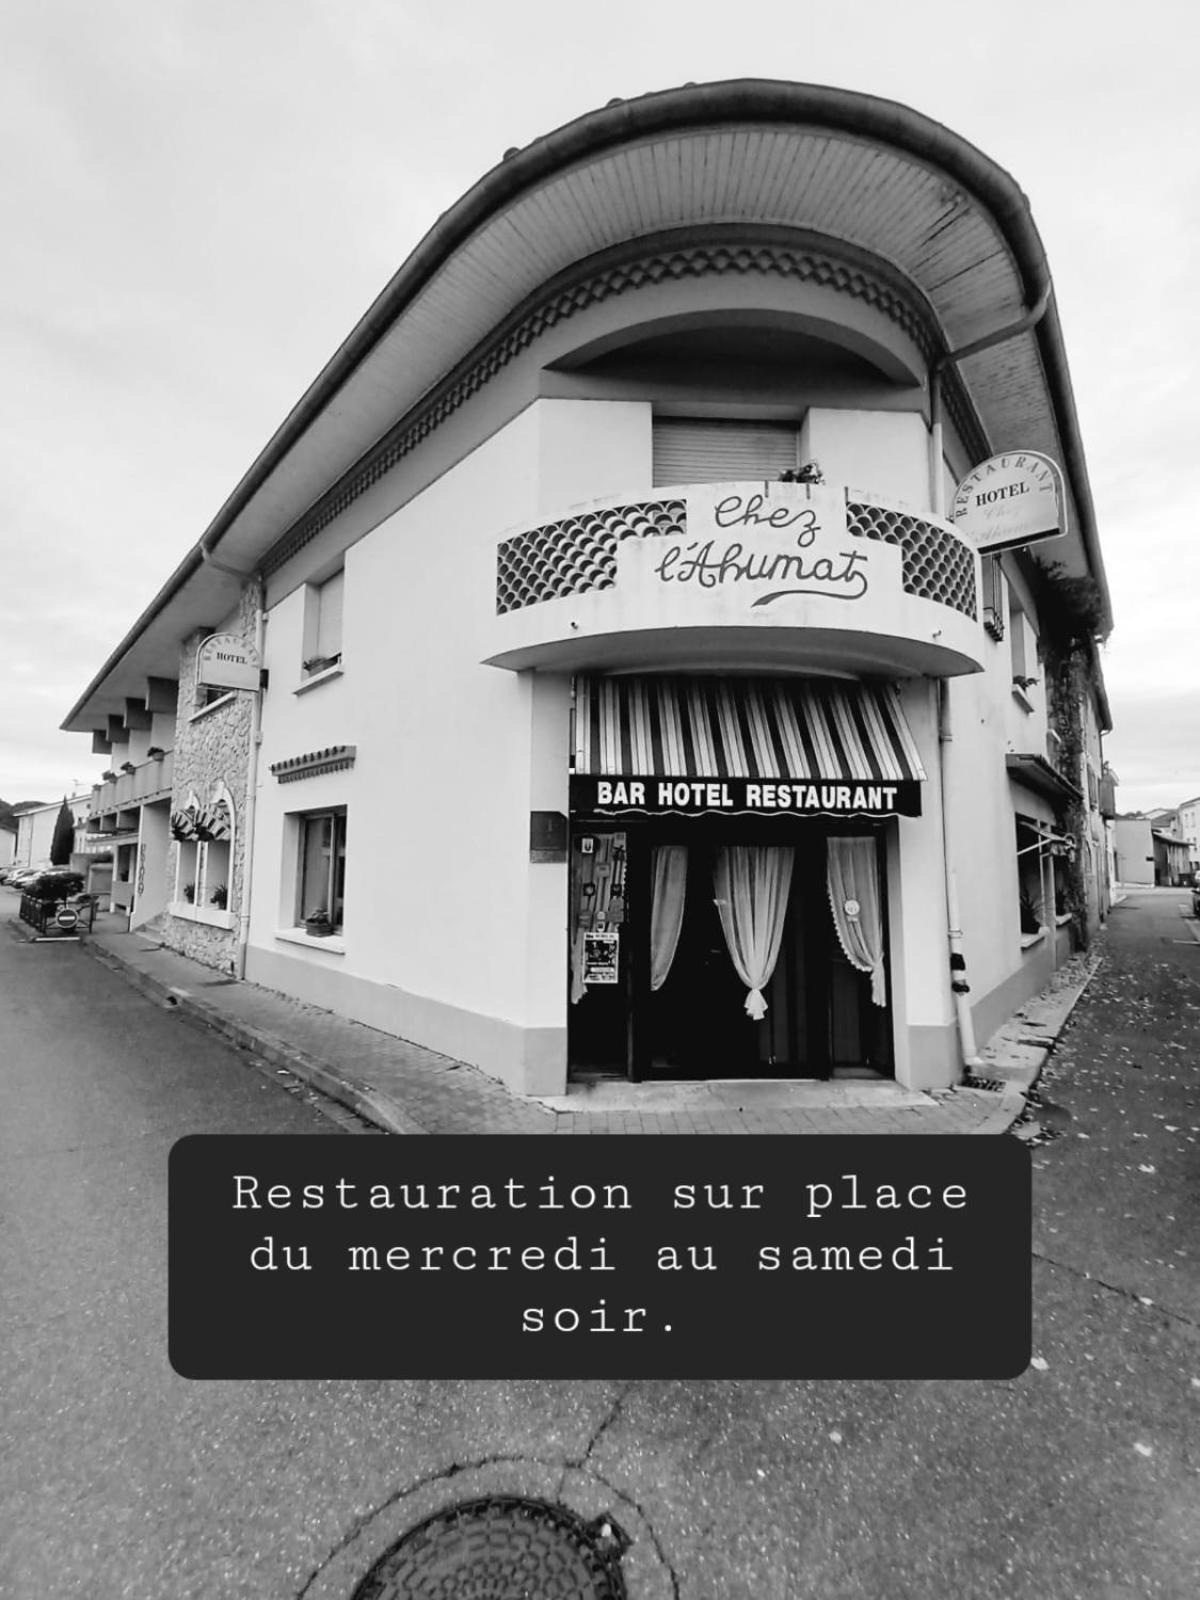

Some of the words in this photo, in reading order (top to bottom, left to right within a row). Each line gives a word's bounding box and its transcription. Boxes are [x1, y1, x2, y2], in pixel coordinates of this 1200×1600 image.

[976, 482, 1030, 506] HOTEL
[715, 494, 822, 548] Chez
[655, 540, 868, 607] l'Ahumat
[216, 652, 248, 664] HOTEL
[597, 781, 646, 805] BAR
[658, 783, 734, 807] HOTEL
[746, 784, 898, 810] RESTAURANT
